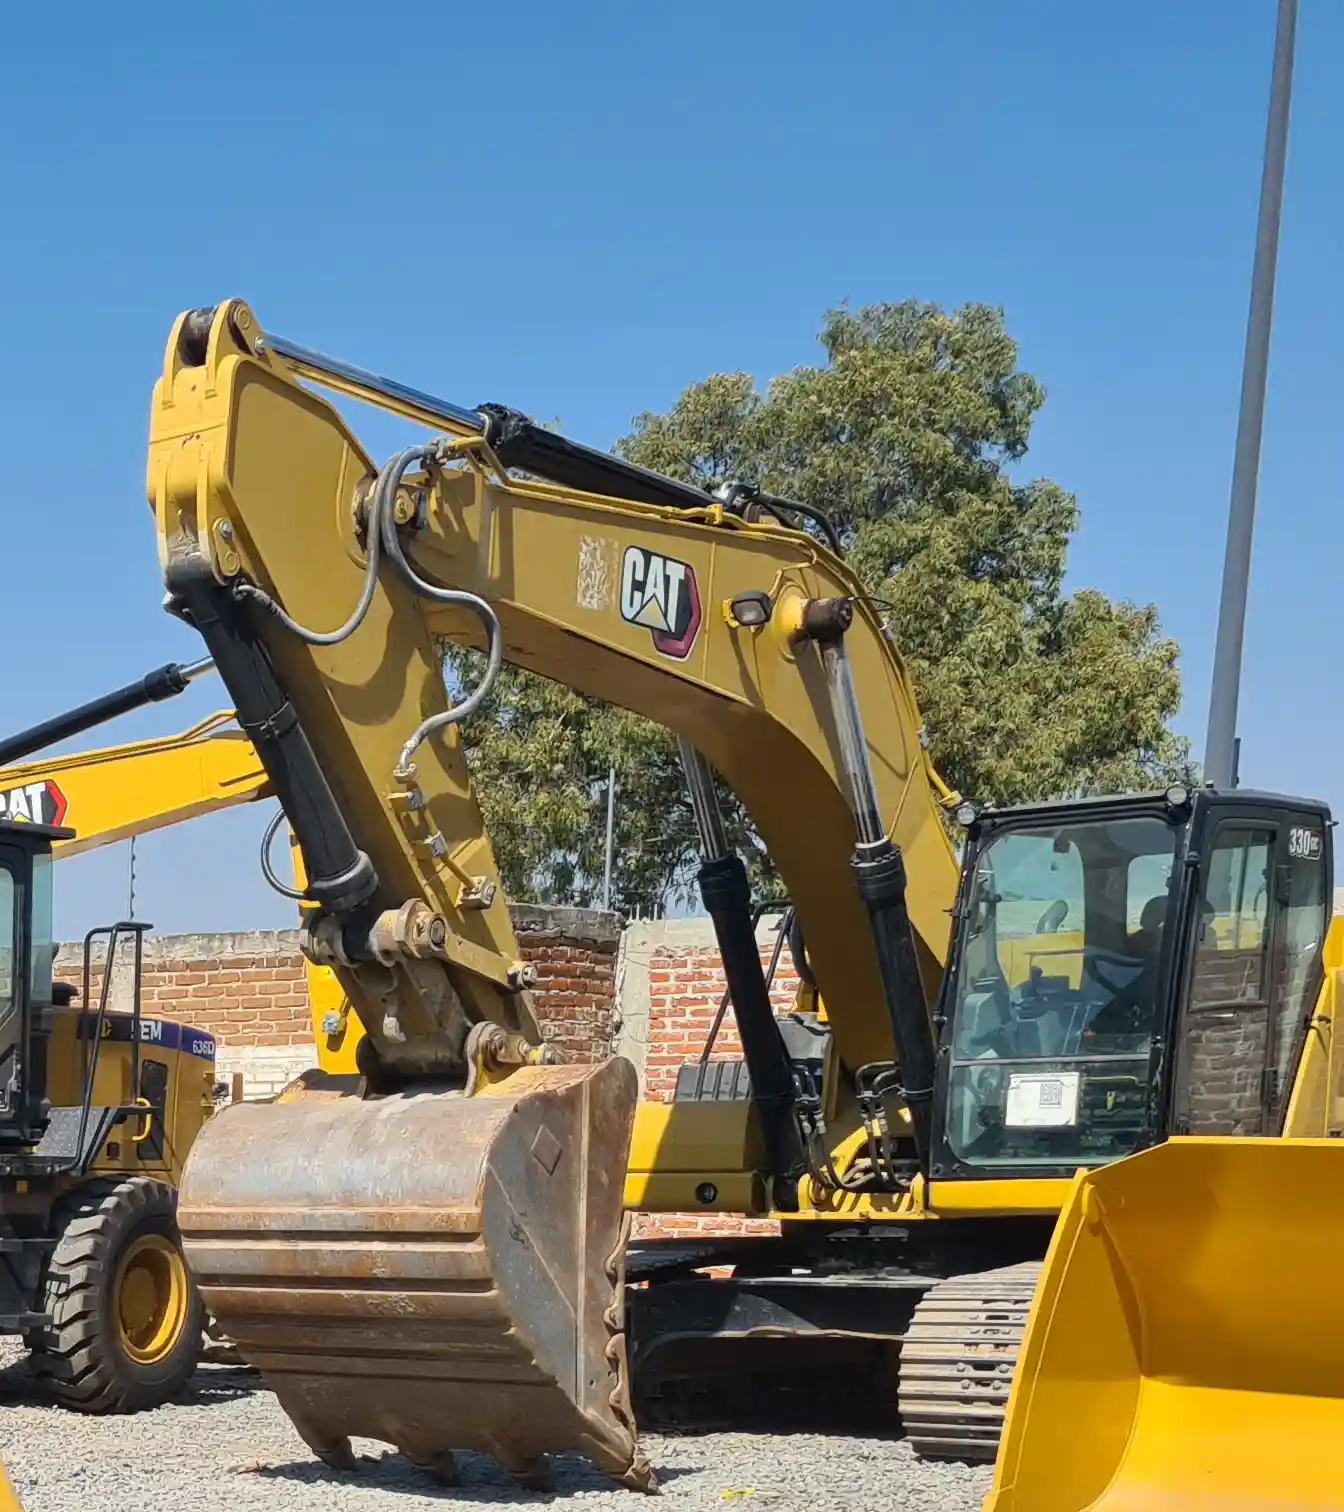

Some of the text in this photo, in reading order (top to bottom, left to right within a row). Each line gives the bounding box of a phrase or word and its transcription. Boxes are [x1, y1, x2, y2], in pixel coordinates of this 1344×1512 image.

[621, 547, 686, 633] CAT
[1289, 827, 1311, 856] 330
[192, 1040, 214, 1055] 636D
